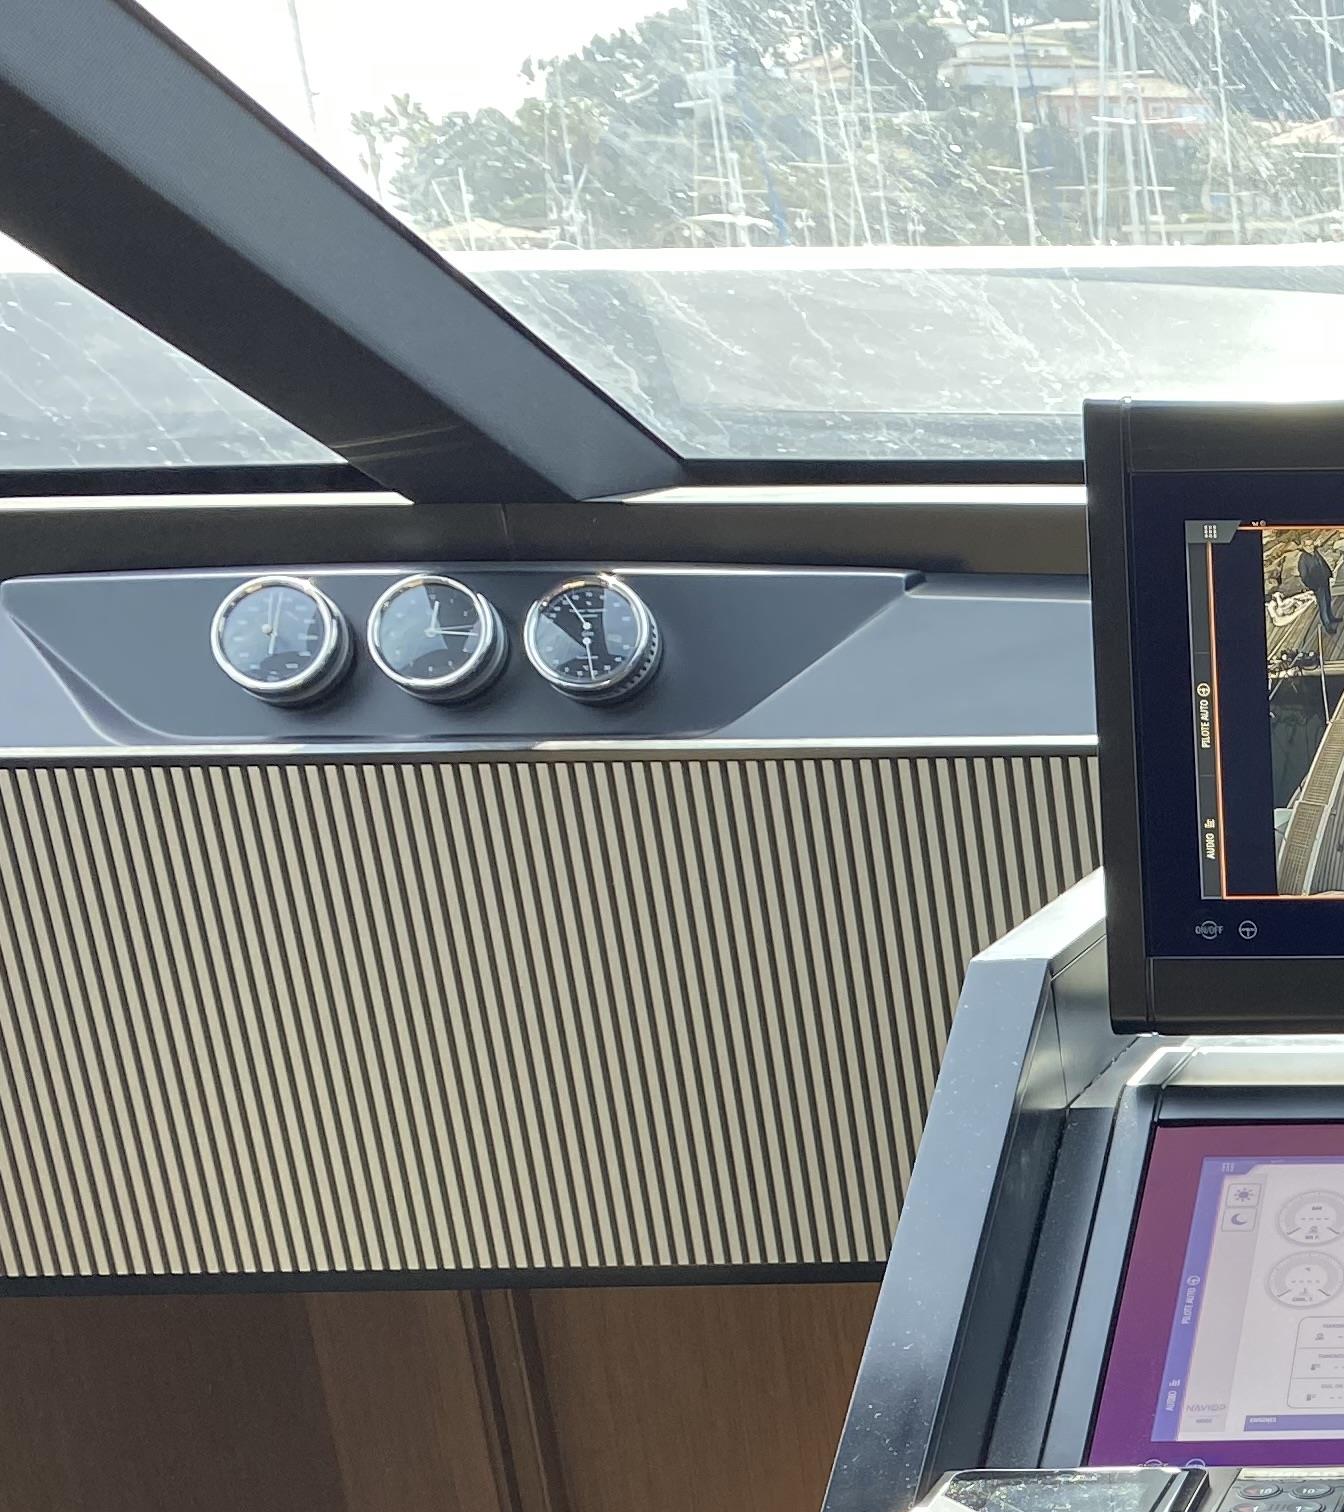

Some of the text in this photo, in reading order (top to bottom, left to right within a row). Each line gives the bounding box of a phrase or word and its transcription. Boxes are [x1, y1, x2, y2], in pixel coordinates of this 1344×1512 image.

[1201, 699, 1210, 720] AUTO
[1206, 832, 1216, 860] AUDIO
[1302, 1487, 1316, 1495] 10
